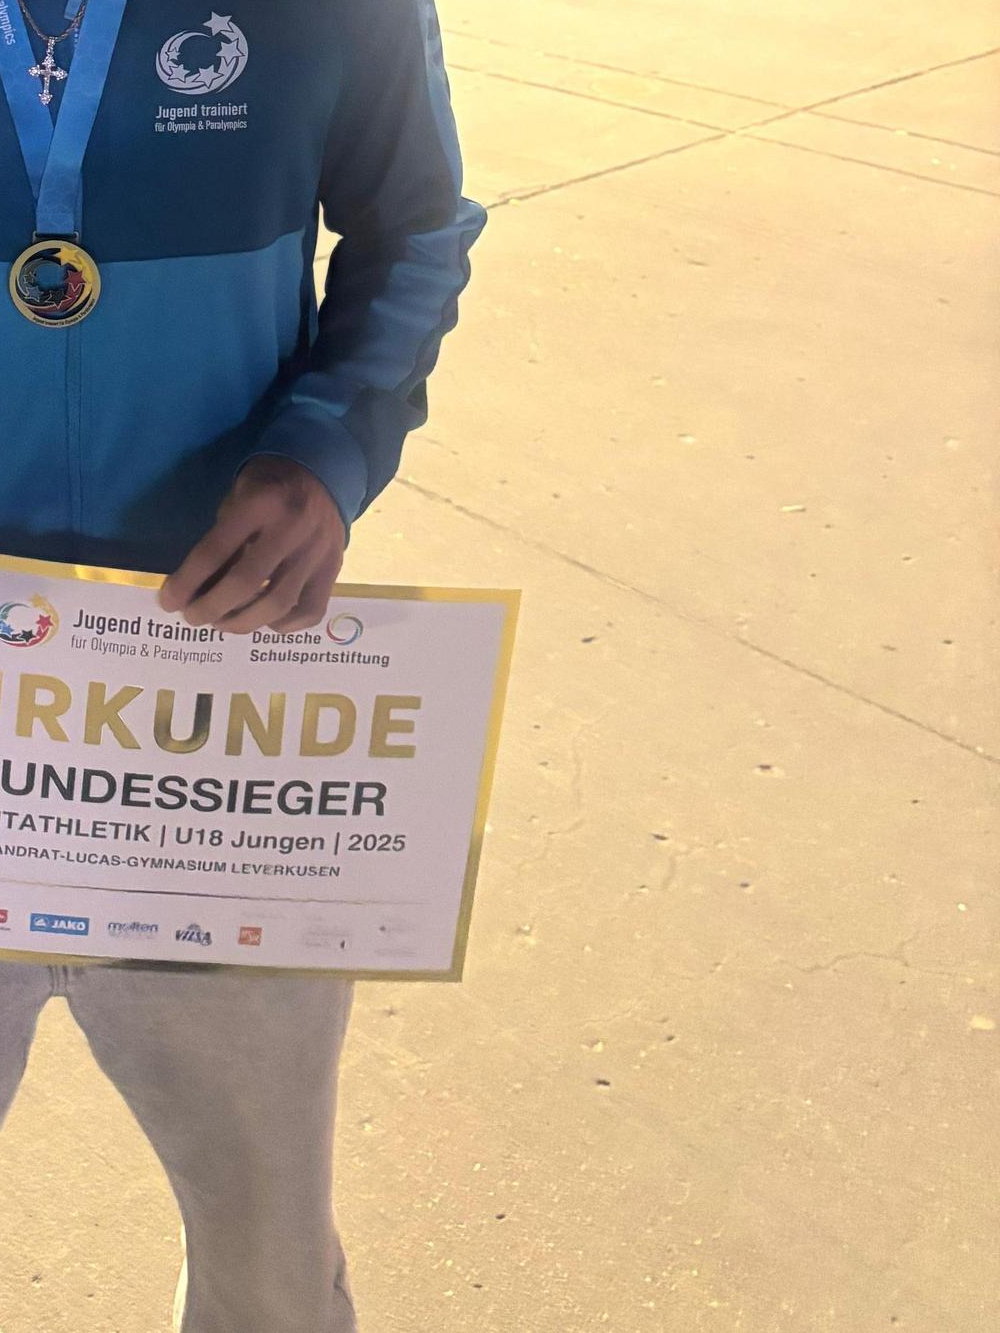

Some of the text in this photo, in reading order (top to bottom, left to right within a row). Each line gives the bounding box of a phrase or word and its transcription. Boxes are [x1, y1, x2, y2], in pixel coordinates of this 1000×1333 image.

[155, 102, 248, 121] Jugend trainiert
[155, 119, 248, 134] für Olympia & Paralympics
[73, 609, 142, 635] Jugend
[252, 631, 322, 644] Deutsche
[91, 637, 137, 656] Olympia
[140, 643, 150, 657] &
[153, 645, 223, 663] Paralympics
[250, 649, 390, 667] Schulsportstiftung
[175, 826, 223, 847] U18
[231, 830, 326, 855] Jungen
[347, 833, 407, 853] 2025
[231, 862, 341, 877] LEVERKUSEN
[51, 918, 87, 932] JAKO
